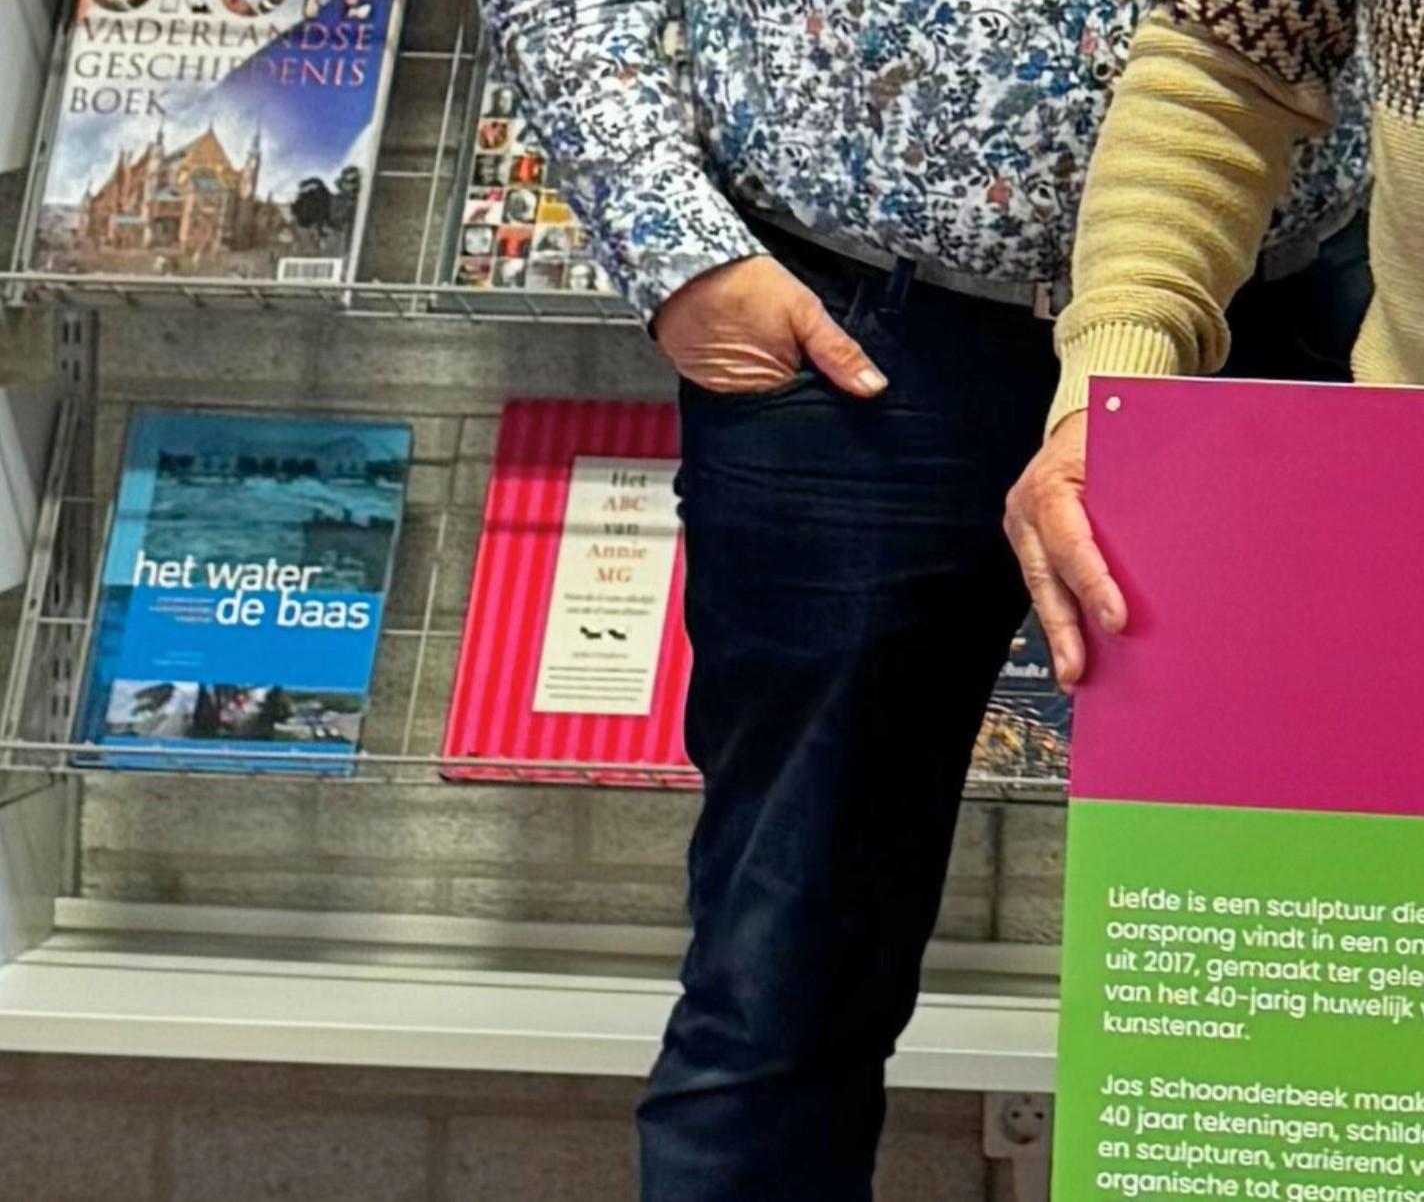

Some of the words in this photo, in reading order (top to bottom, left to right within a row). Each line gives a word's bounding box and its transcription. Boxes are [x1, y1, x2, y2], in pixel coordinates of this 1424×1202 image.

[81, 16, 376, 52] VADERLANDSE
[69, 86, 168, 116] BOEK
[610, 470, 647, 488] Het
[602, 496, 648, 512] ABC
[603, 523, 640, 536] van
[586, 544, 648, 559] Annie
[131, 550, 198, 589] het
[206, 557, 323, 592] water
[594, 567, 632, 583] MG
[215, 589, 265, 626] de
[276, 588, 371, 629] baas
[1108, 886, 1181, 912] Liefde
[1187, 888, 1207, 914] is
[1213, 896, 1260, 917] een
[1266, 895, 1385, 924] sculptuur
[1106, 921, 1236, 952] oorsprong
[1241, 924, 1305, 951] vindt
[1311, 927, 1334, 952] in
[1340, 933, 1389, 955] een
[1105, 951, 1137, 972] uit
[1143, 951, 1200, 977] 2017,
[1206, 955, 1321, 986] gemaakt
[1328, 961, 1362, 984] ter
[1104, 984, 1152, 1003] van
[1158, 982, 1199, 1006] het
[1204, 986, 1307, 1019] 40-jarig
[1312, 992, 1414, 1025] huwelijk
[1103, 1010, 1251, 1041] kunstenaar.
[1100, 1073, 1143, 1097] Jos
[1149, 1077, 1348, 1109] Schoonderbeek
[1099, 1105, 1131, 1127] 40
[1135, 1107, 1187, 1135] jaar
[1193, 1112, 1341, 1144] tekeningen,
[1097, 1140, 1130, 1159] en
[1135, 1139, 1276, 1171] sculpturen,
[1096, 1169, 1239, 1196] organische
[1244, 1176, 1280, 1198] tot
